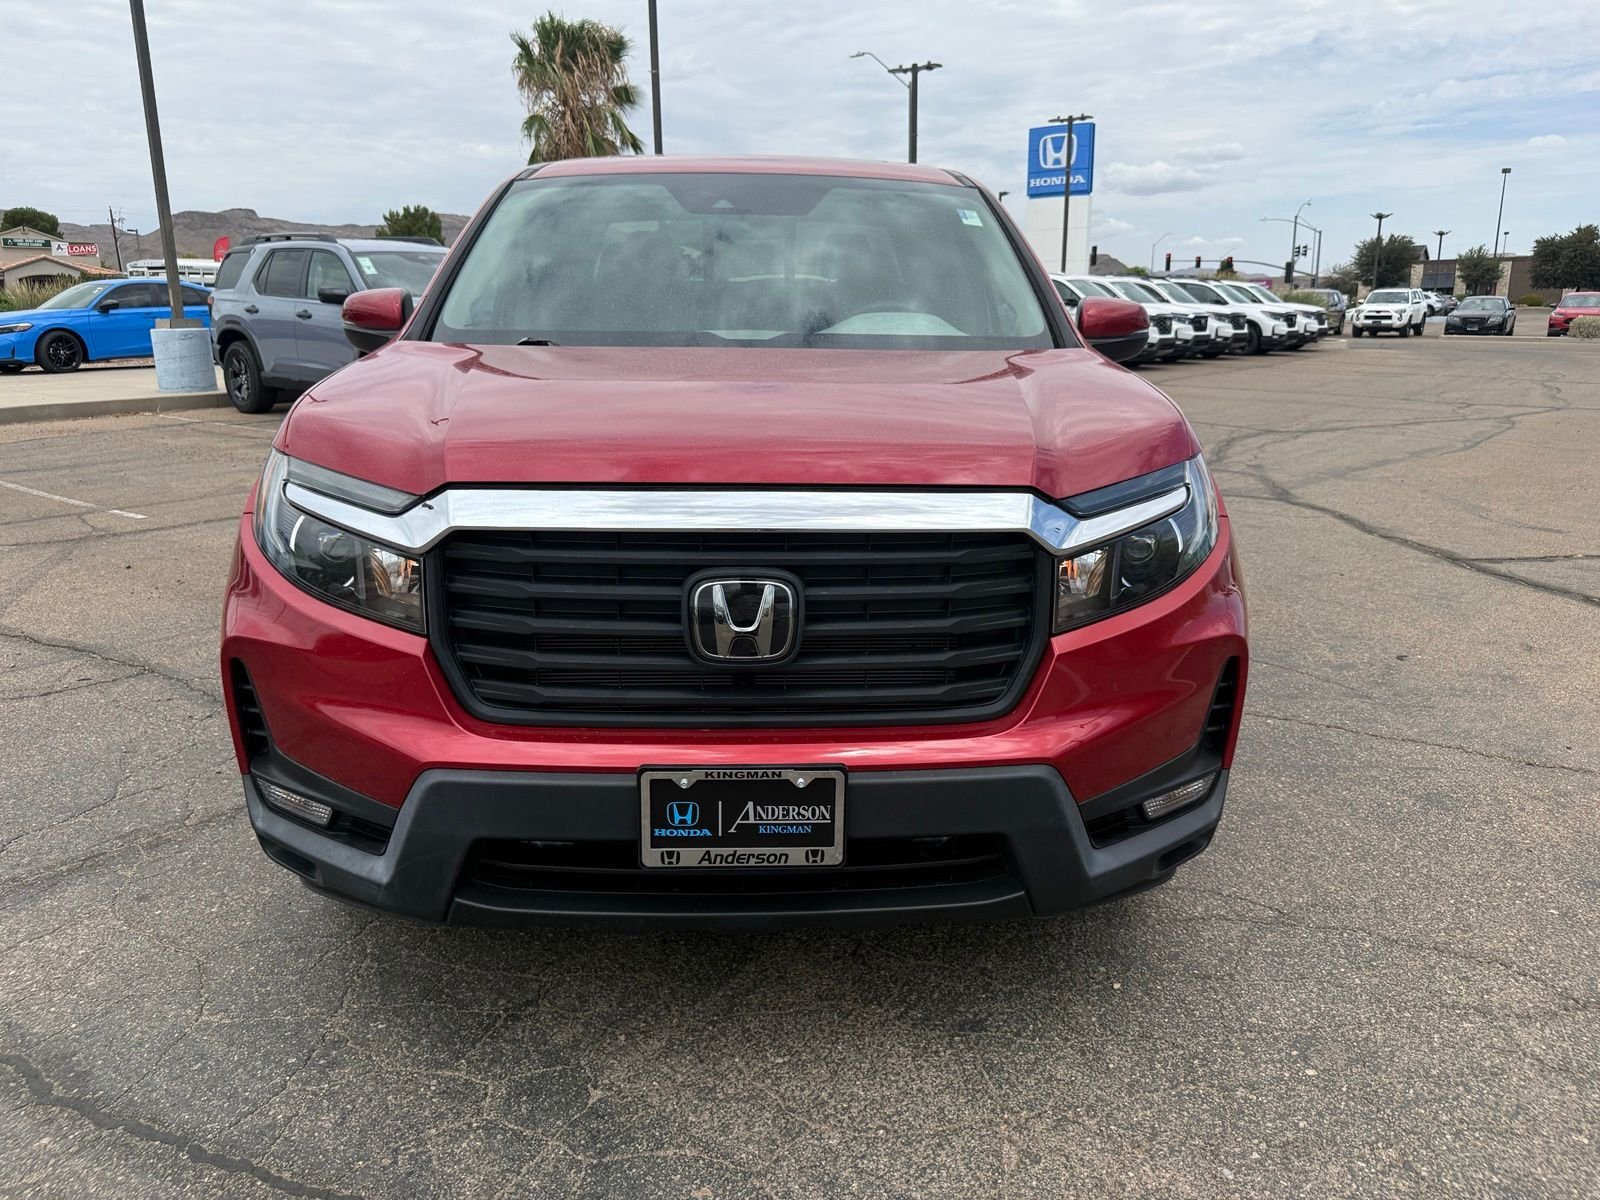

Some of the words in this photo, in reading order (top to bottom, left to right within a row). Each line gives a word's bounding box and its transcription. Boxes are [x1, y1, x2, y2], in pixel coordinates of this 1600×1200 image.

[1029, 175, 1087, 188] HONDA
[704, 770, 783, 779] KINGMAN
[727, 800, 832, 833] ANDERSON
[653, 828, 713, 837] HONDA
[758, 825, 813, 834] KINGMAN
[697, 850, 790, 865] Anderson
